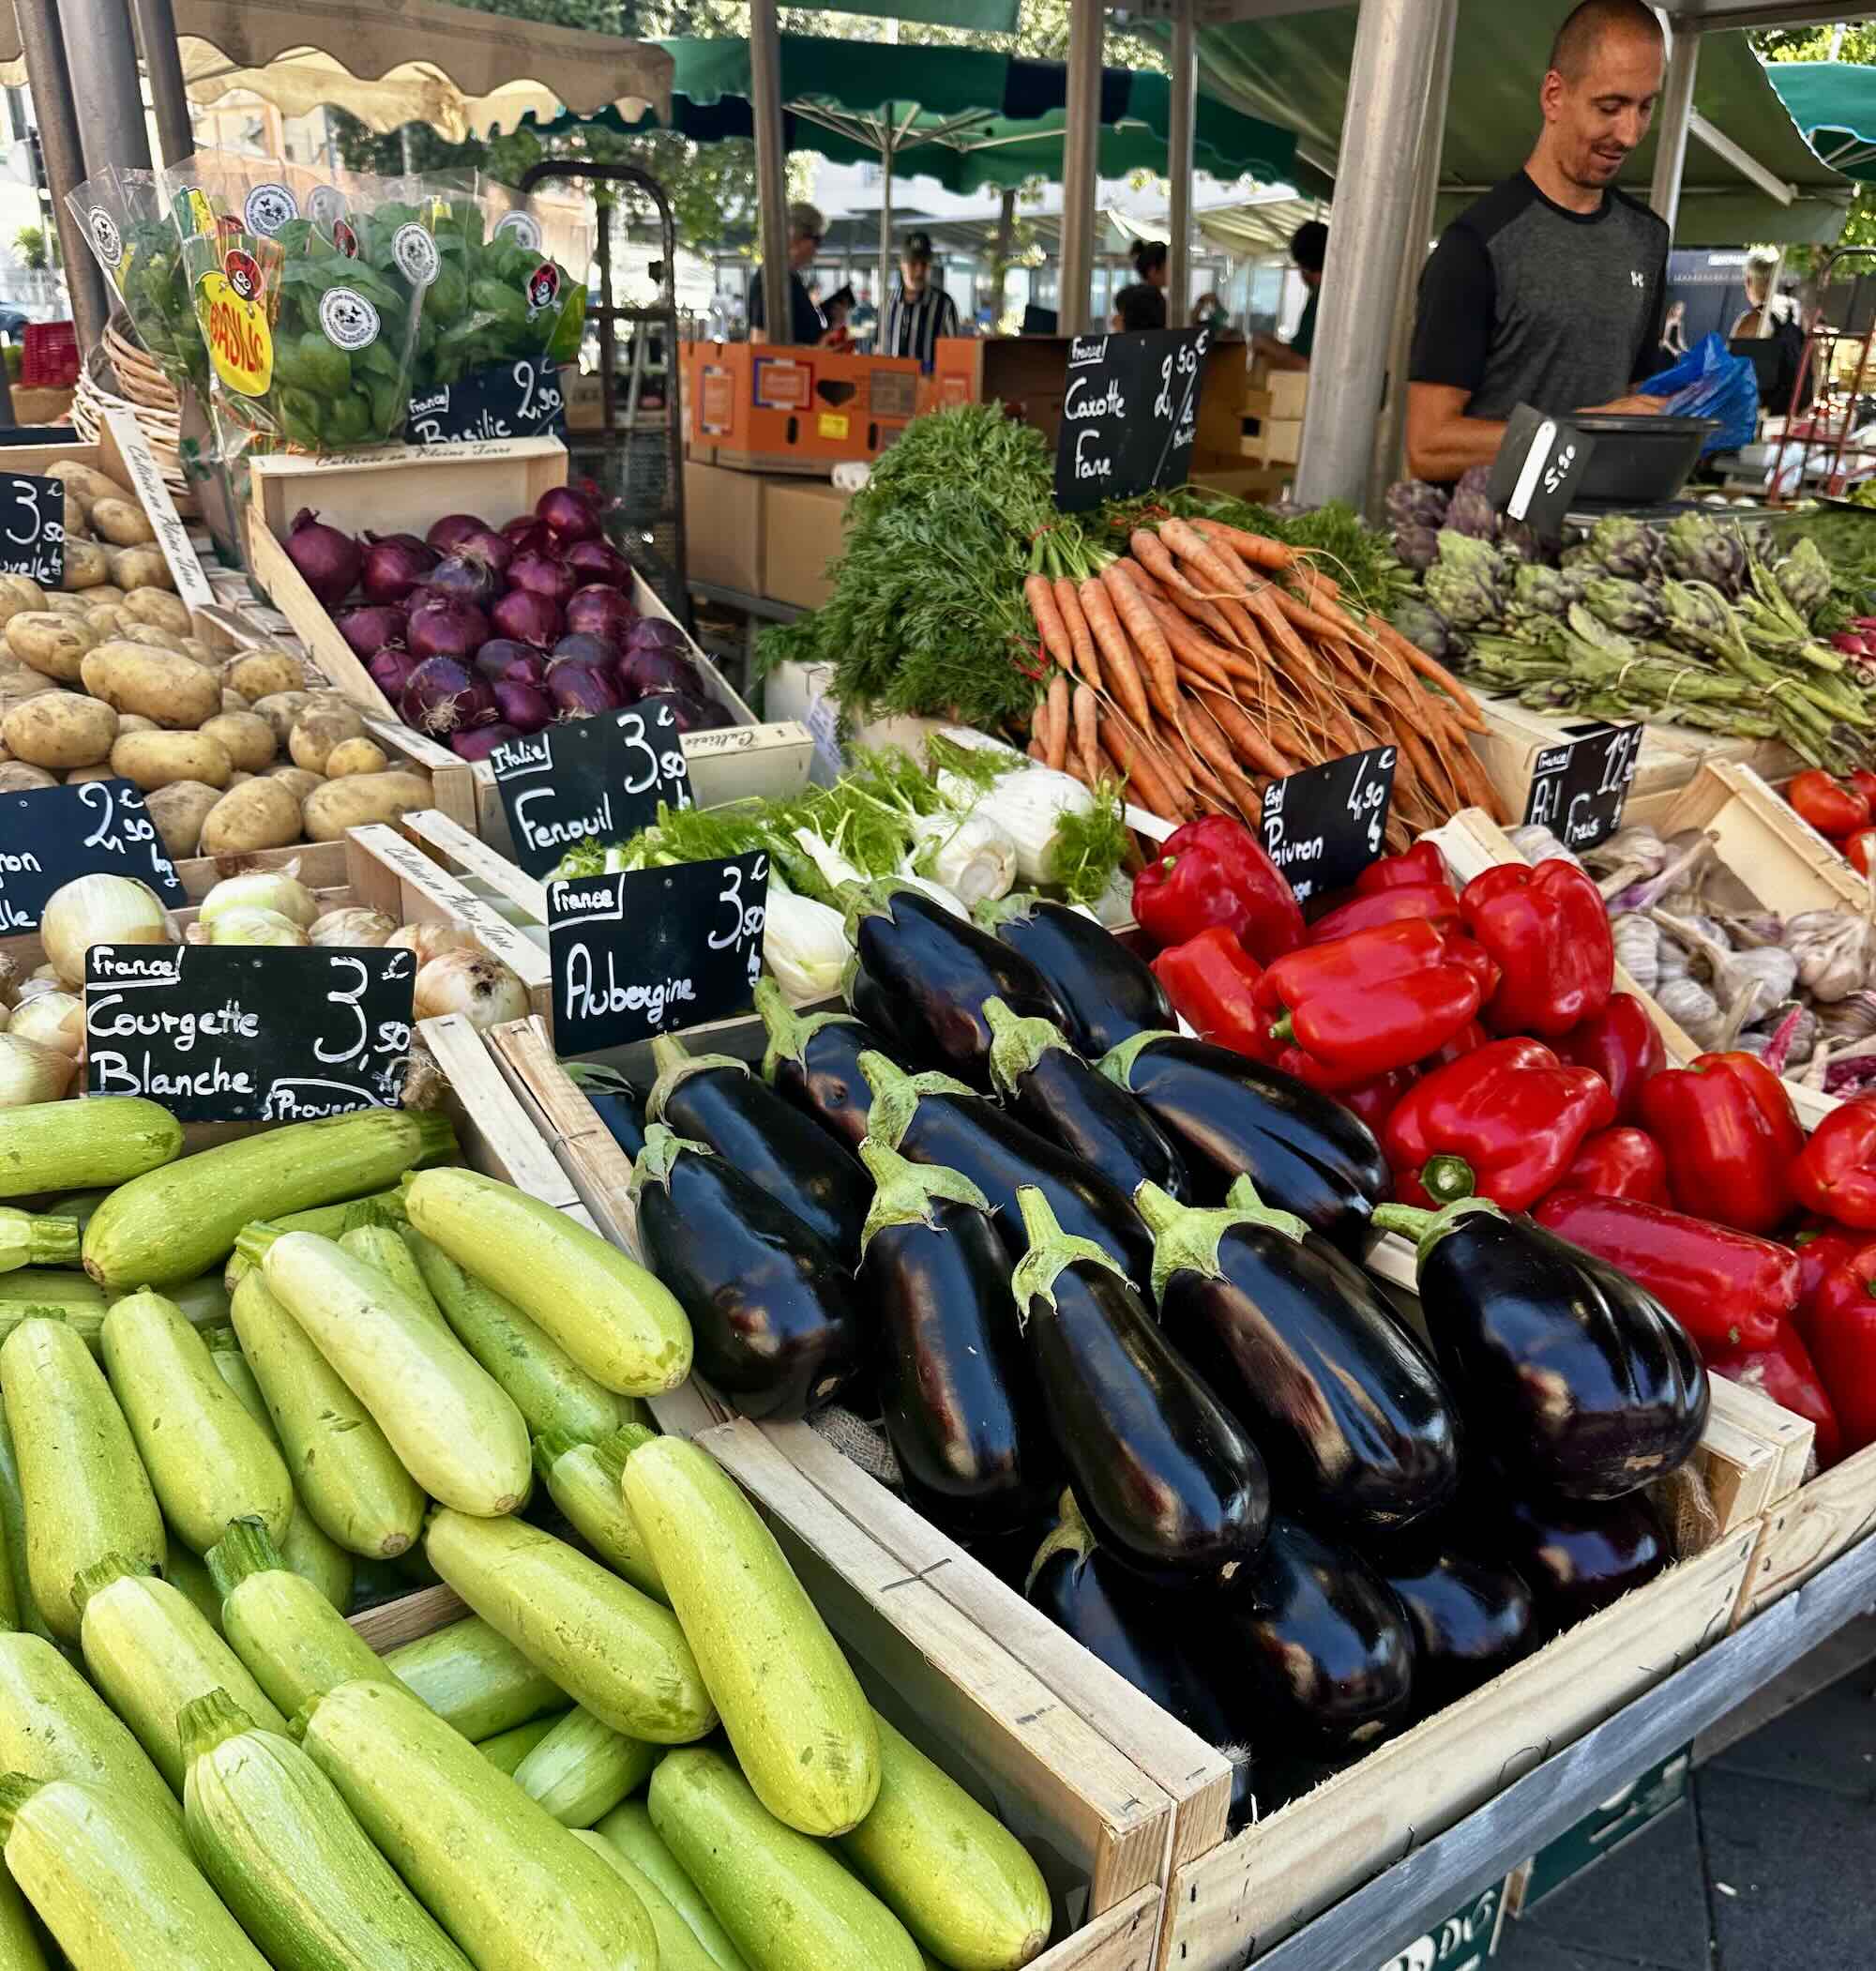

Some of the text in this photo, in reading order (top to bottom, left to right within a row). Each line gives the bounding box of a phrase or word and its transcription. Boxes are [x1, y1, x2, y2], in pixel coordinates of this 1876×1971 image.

[1194, 329, 1209, 356] €
[409, 392, 446, 415] France
[414, 408, 512, 444] Basilic
[1075, 429, 1112, 478] Fane
[491, 741, 546, 774] Italie
[515, 786, 614, 852] Fenouil
[1530, 779, 1562, 826] Ail
[552, 880, 615, 913] France
[92, 945, 177, 978] France
[566, 942, 697, 1023] Aubergine
[86, 993, 261, 1052] Courgette
[314, 956, 411, 1072] 3,50
[89, 1049, 255, 1097] Blanche
